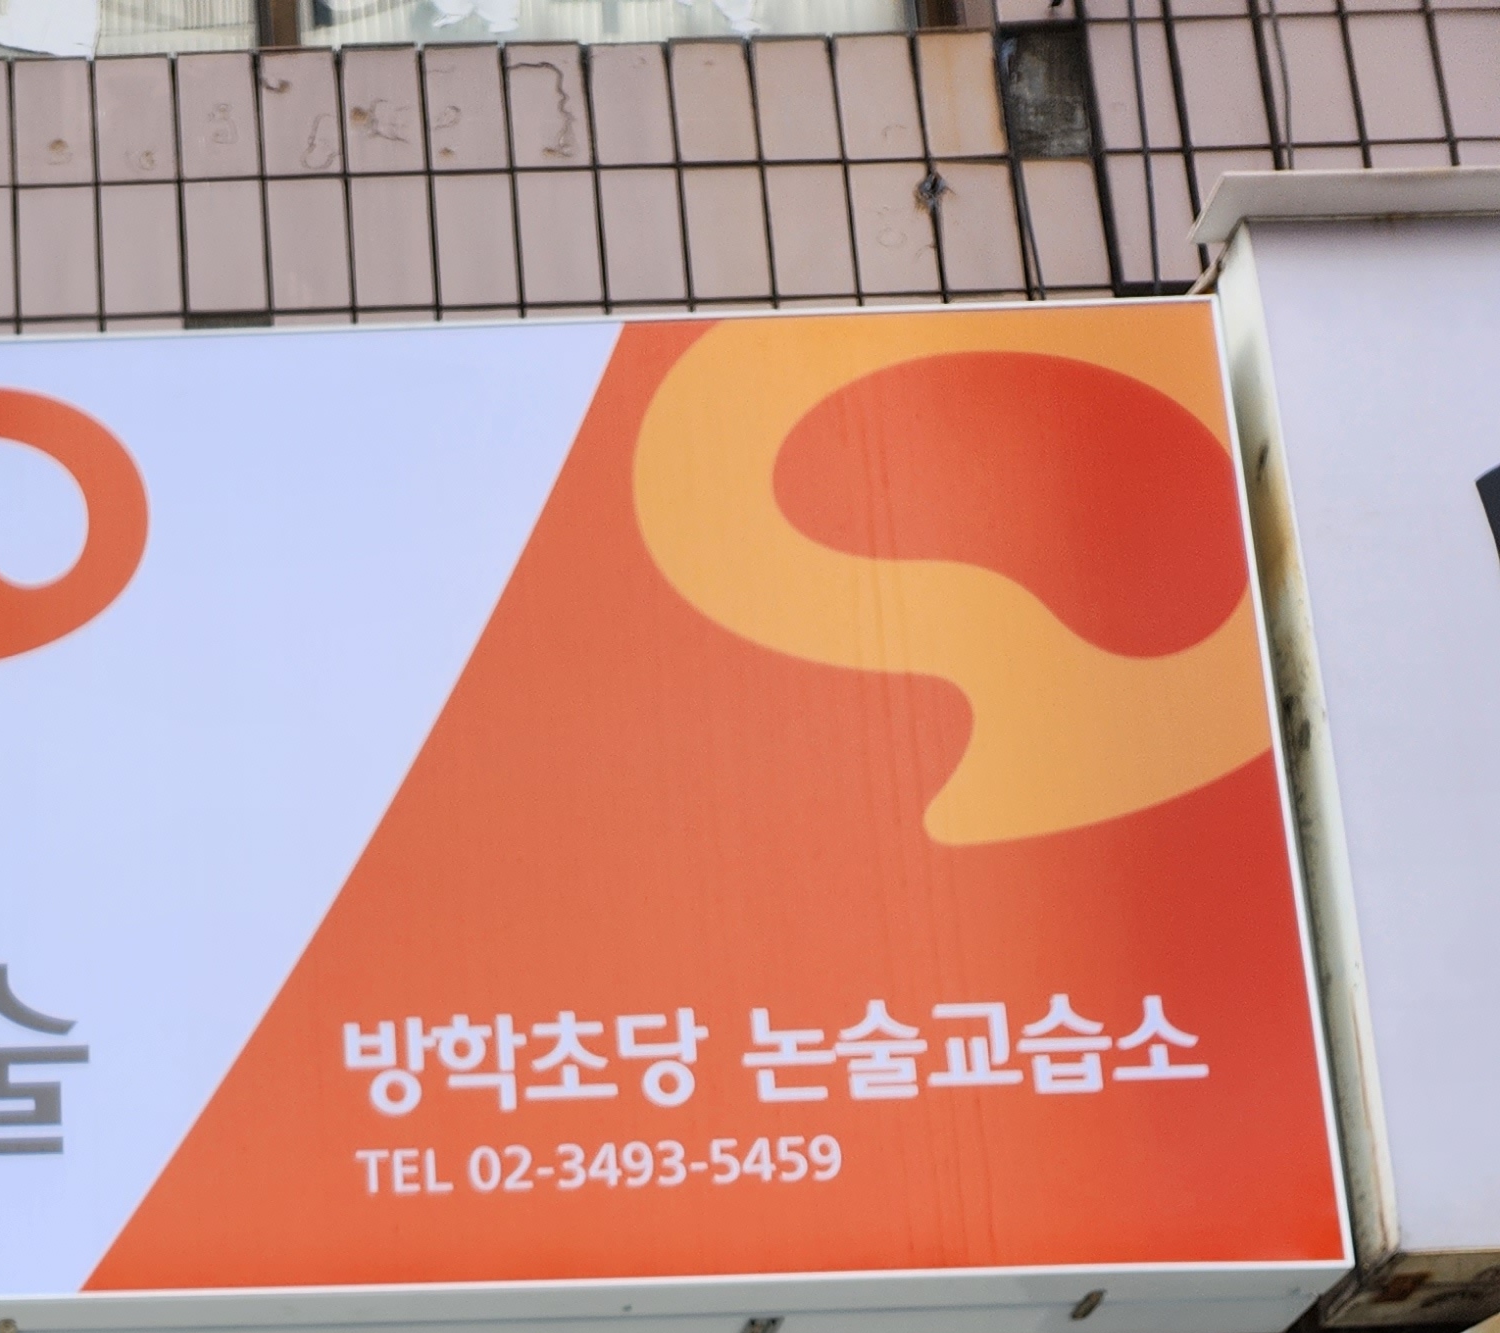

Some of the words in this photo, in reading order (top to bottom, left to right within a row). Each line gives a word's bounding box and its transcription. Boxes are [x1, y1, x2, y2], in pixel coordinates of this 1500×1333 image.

[342, 1007, 709, 1117] 방학초당
[741, 994, 1210, 1103] 논술교습소
[355, 1148, 454, 1194] TEL
[467, 1134, 843, 1192] 02-3493-5459
